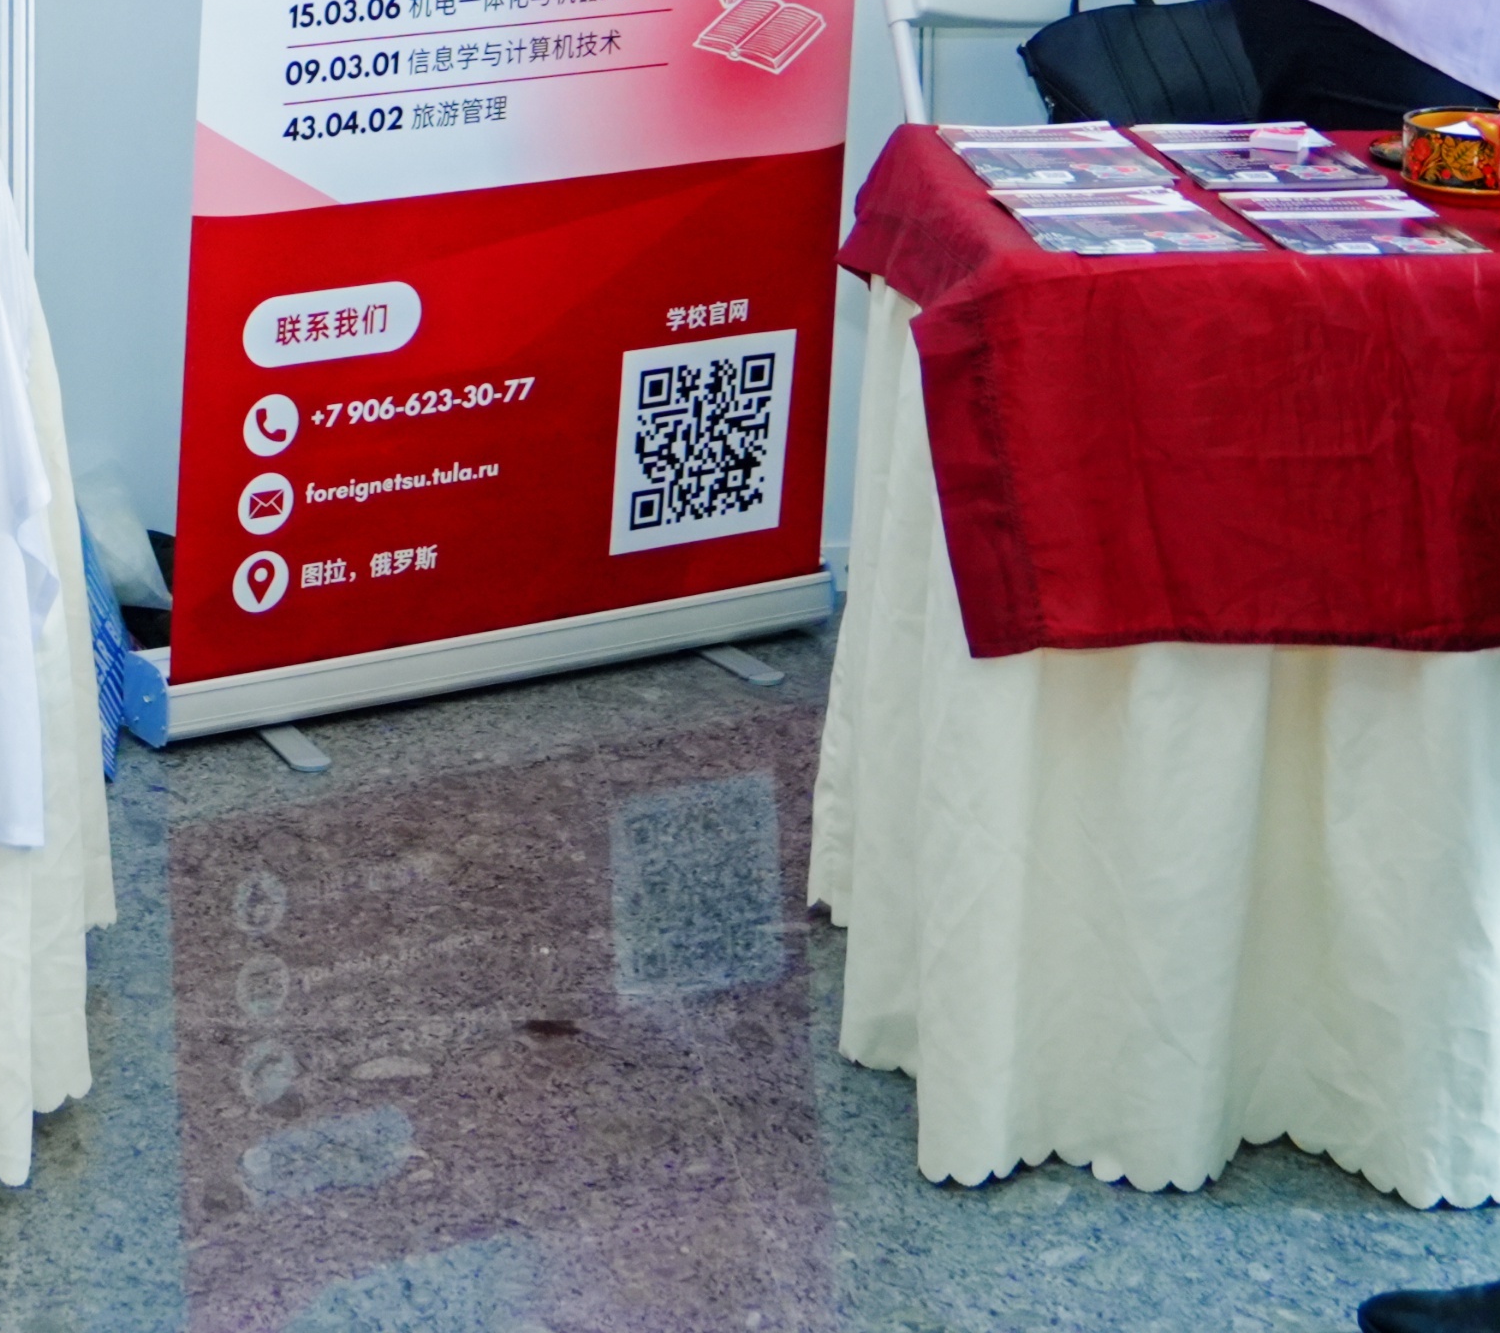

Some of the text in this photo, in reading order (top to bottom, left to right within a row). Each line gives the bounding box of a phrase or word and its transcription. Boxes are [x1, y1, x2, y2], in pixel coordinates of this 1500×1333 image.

[285, 30, 621, 86] 09.03.01 信息学与计算机技术
[283, 96, 508, 141] 43.04.02 旅游管理
[274, 304, 389, 345] 联系我们
[666, 297, 749, 333] 学校官网
[311, 377, 535, 428] +7 906-623-30-77
[305, 462, 499, 504] foreign@tsu.tula.ru
